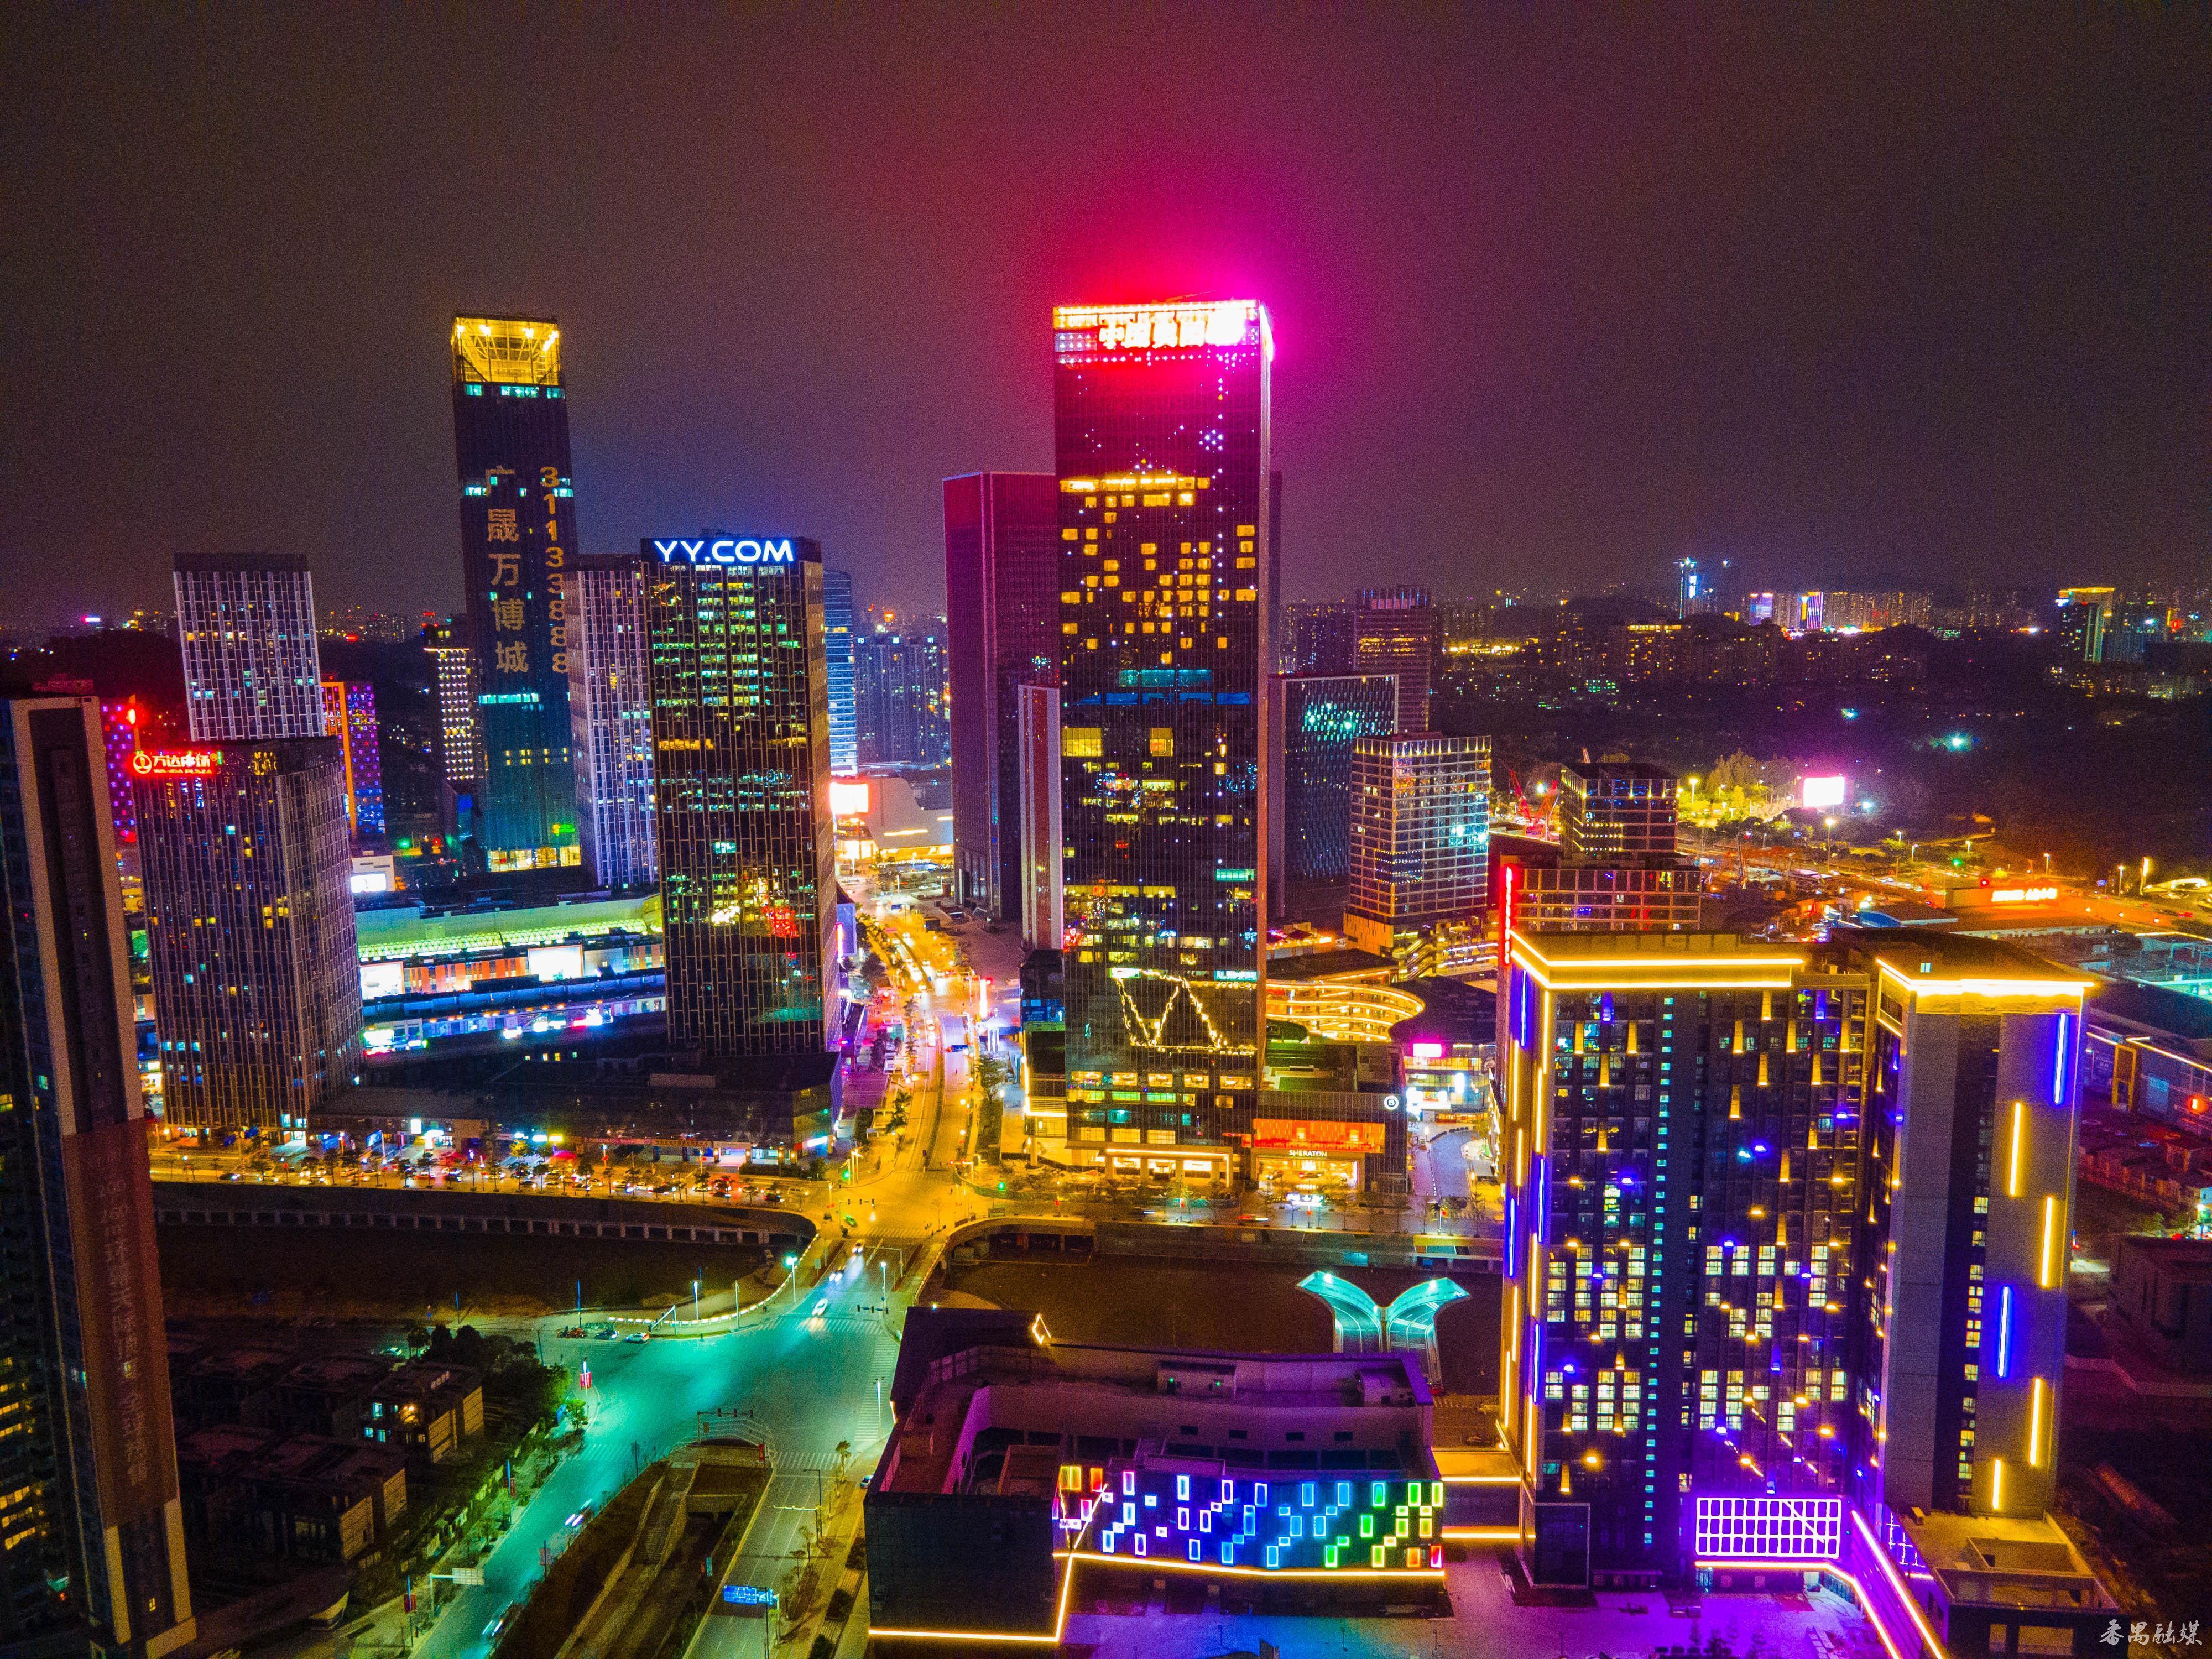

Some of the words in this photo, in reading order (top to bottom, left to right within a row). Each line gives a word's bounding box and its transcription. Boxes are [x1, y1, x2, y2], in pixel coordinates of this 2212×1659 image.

[486, 465, 528, 673] 广晟万博城
[540, 466, 569, 673] 31133888
[654, 540, 794, 562] YY.COM
